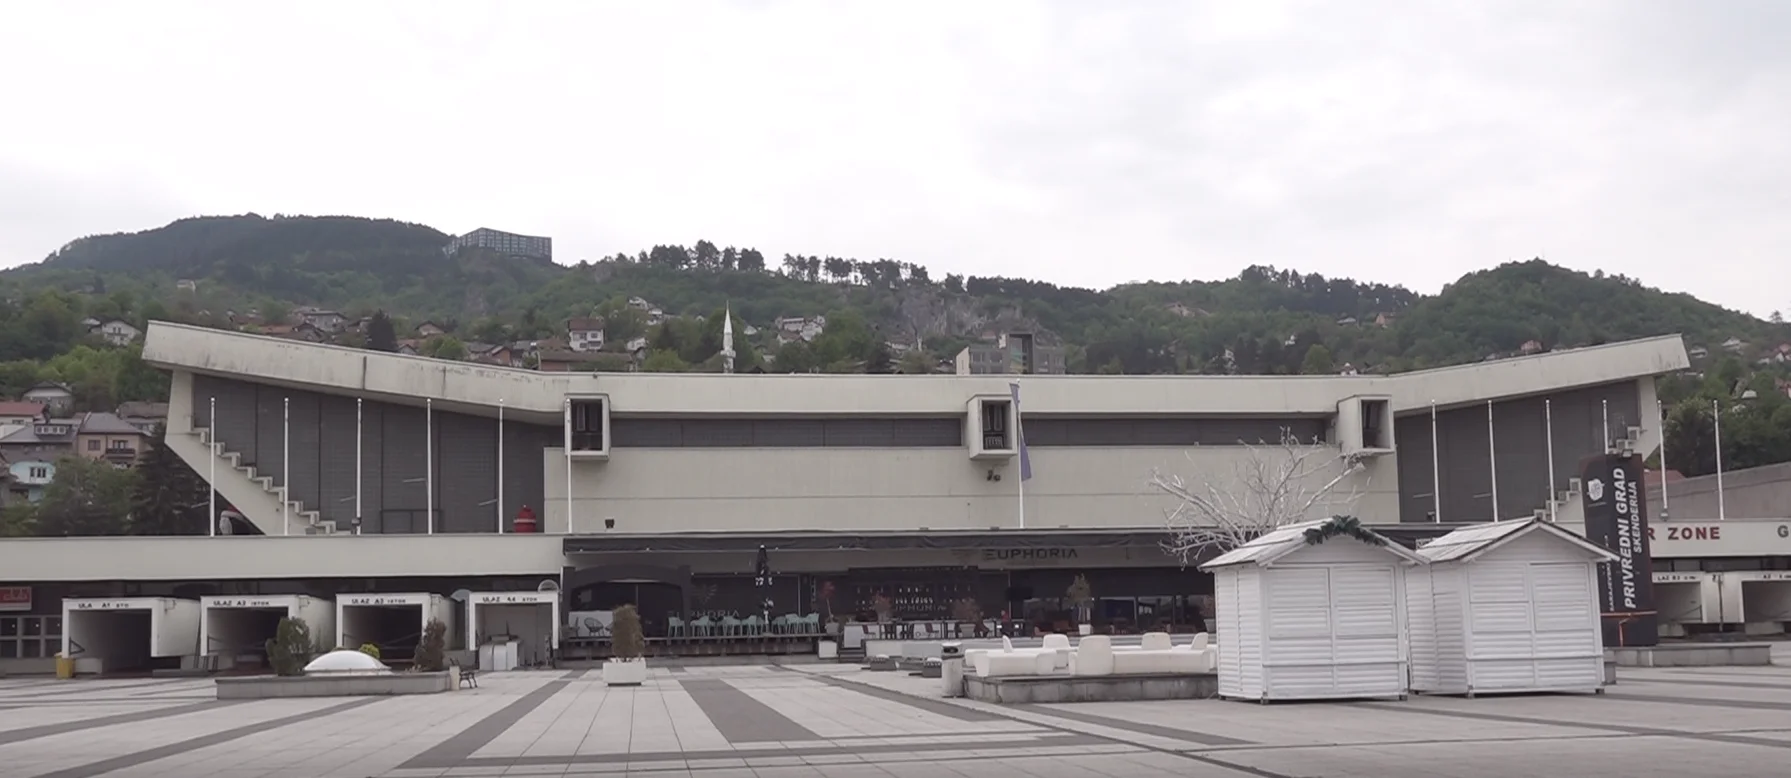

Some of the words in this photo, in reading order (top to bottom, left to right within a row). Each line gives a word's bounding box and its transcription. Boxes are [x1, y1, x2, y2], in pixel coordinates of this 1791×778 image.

[1613, 468, 1627, 514] GRAD
[1628, 481, 1642, 553] SKENDERIJA
[1667, 526, 1720, 540] ZONE
[981, 548, 1078, 560] EUPHORIA
[1617, 518, 1637, 608] PRIVREDNI
